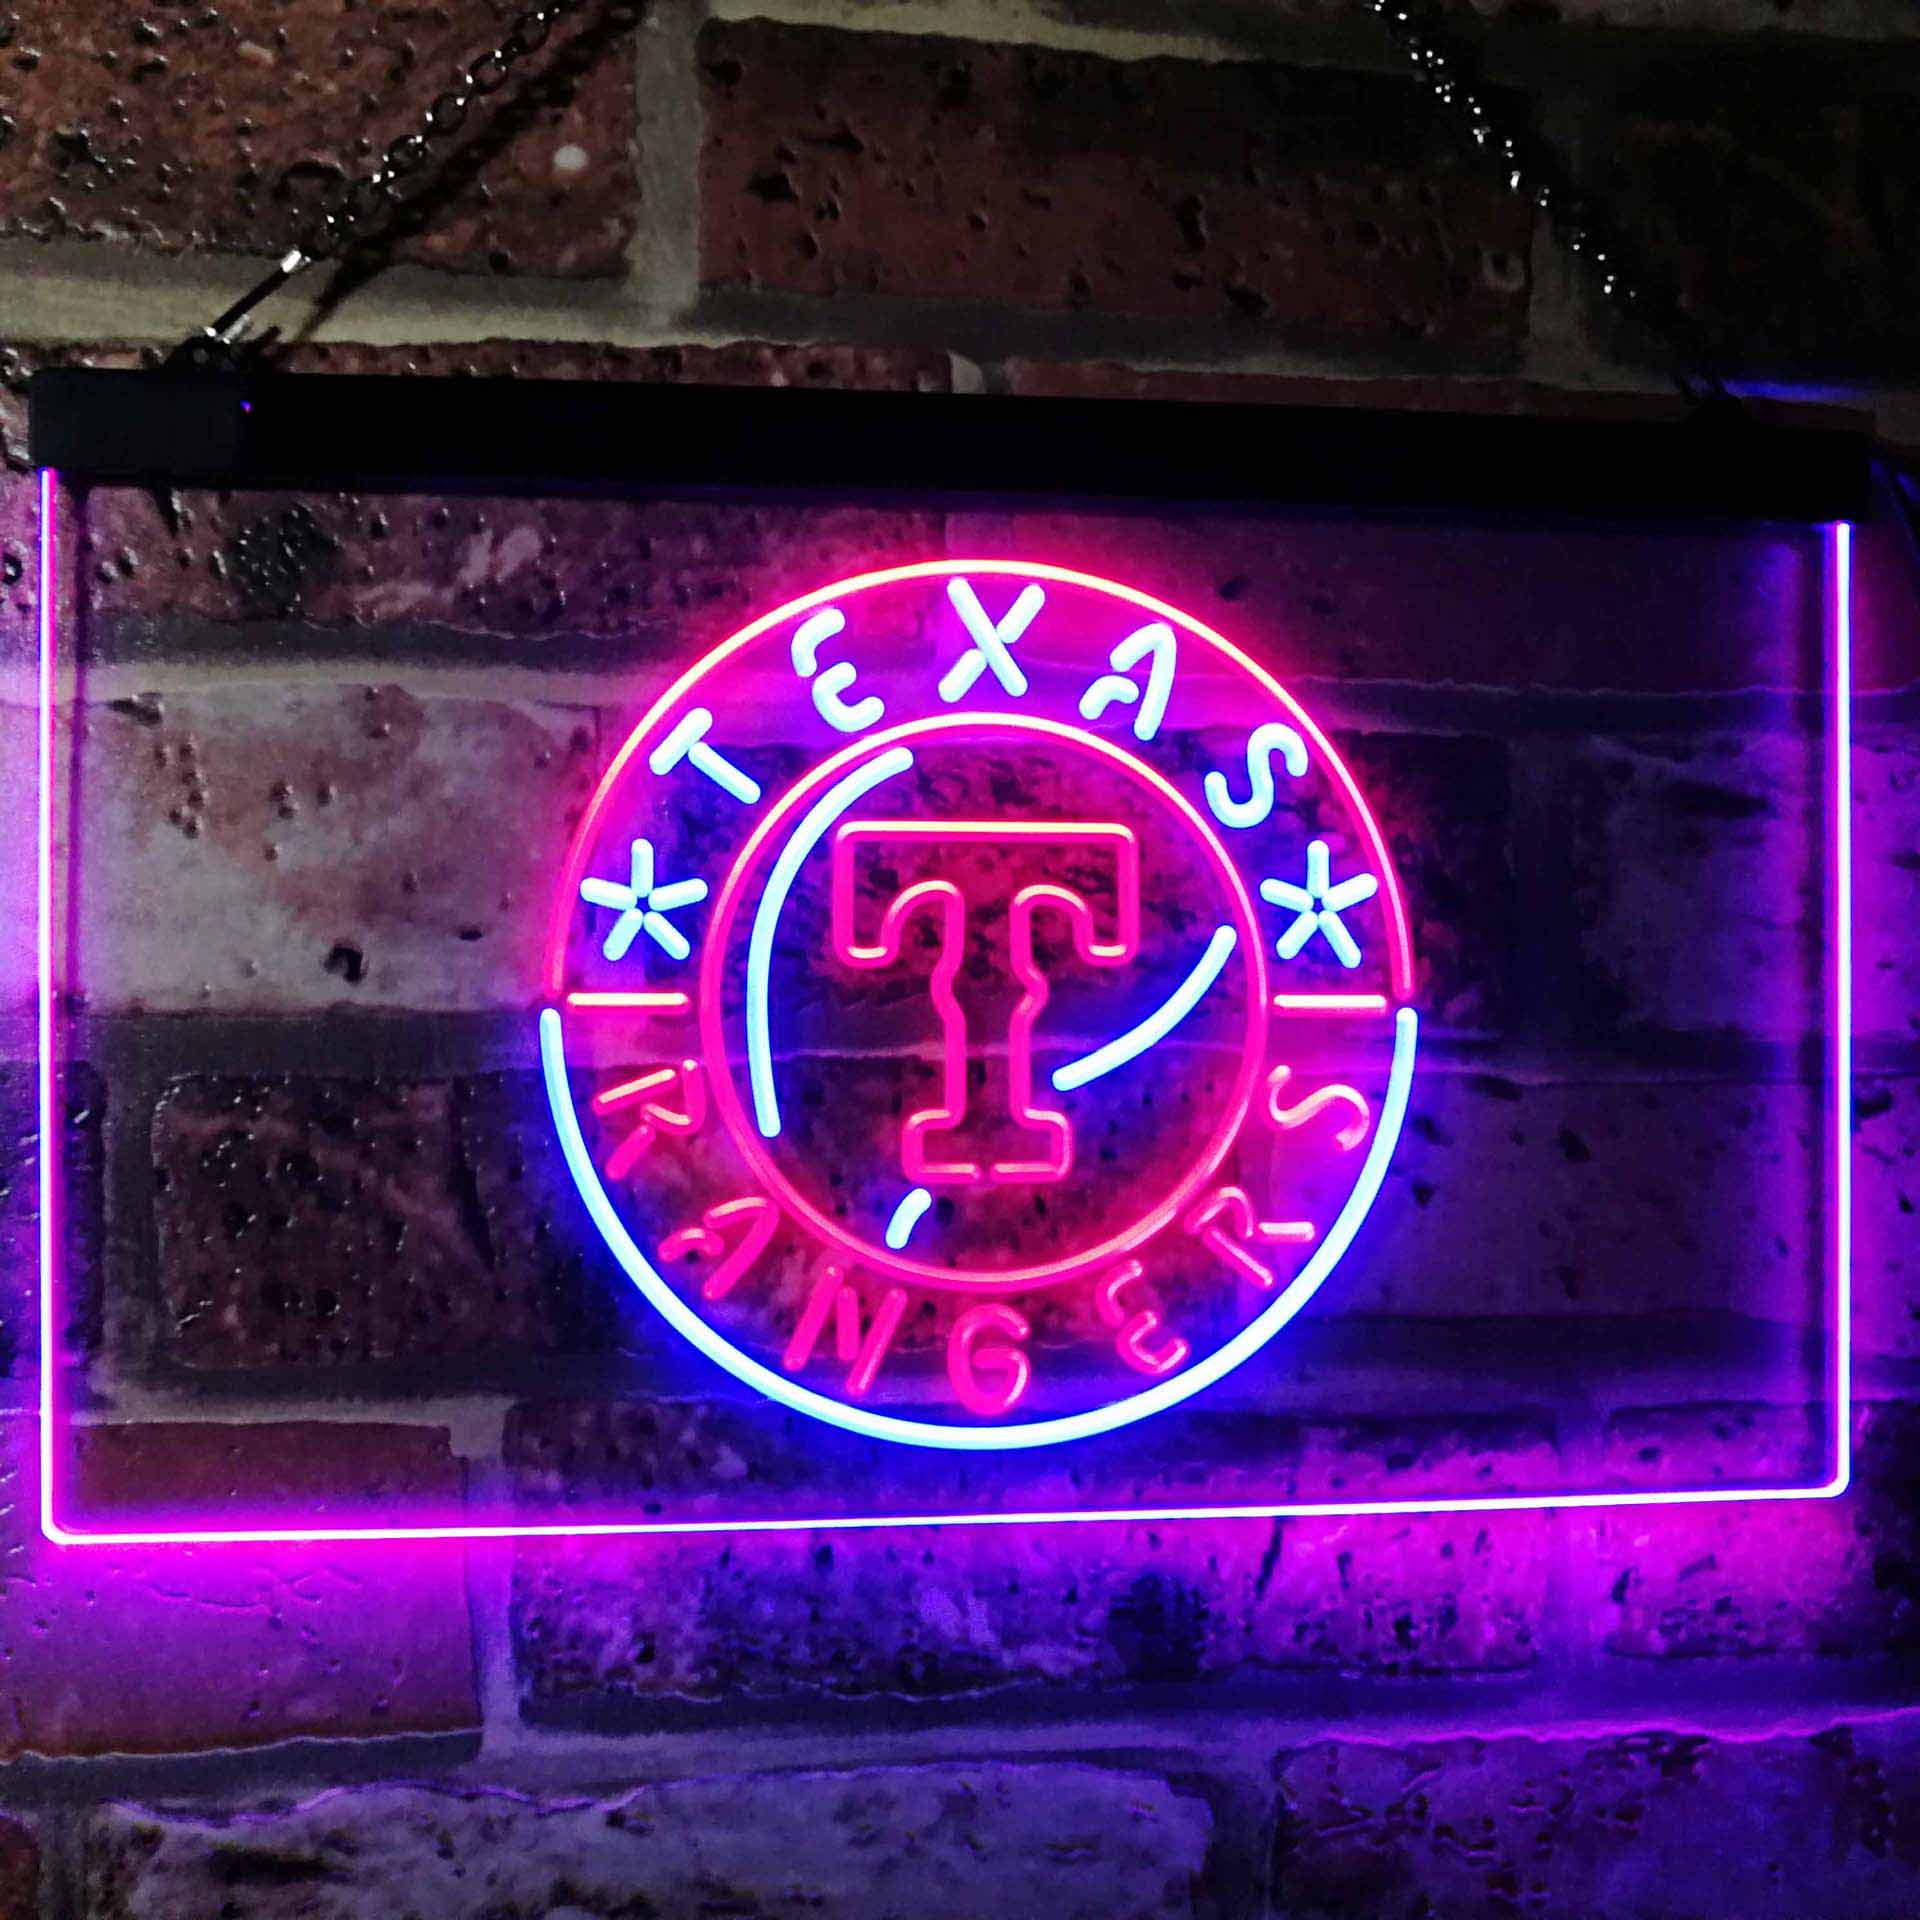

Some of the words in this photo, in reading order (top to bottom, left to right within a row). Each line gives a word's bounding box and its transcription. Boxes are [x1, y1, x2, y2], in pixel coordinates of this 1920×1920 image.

[649, 576, 1309, 829] TEXAS
[832, 820, 1140, 1184] T
[594, 1058, 1371, 1416] RANGERS
